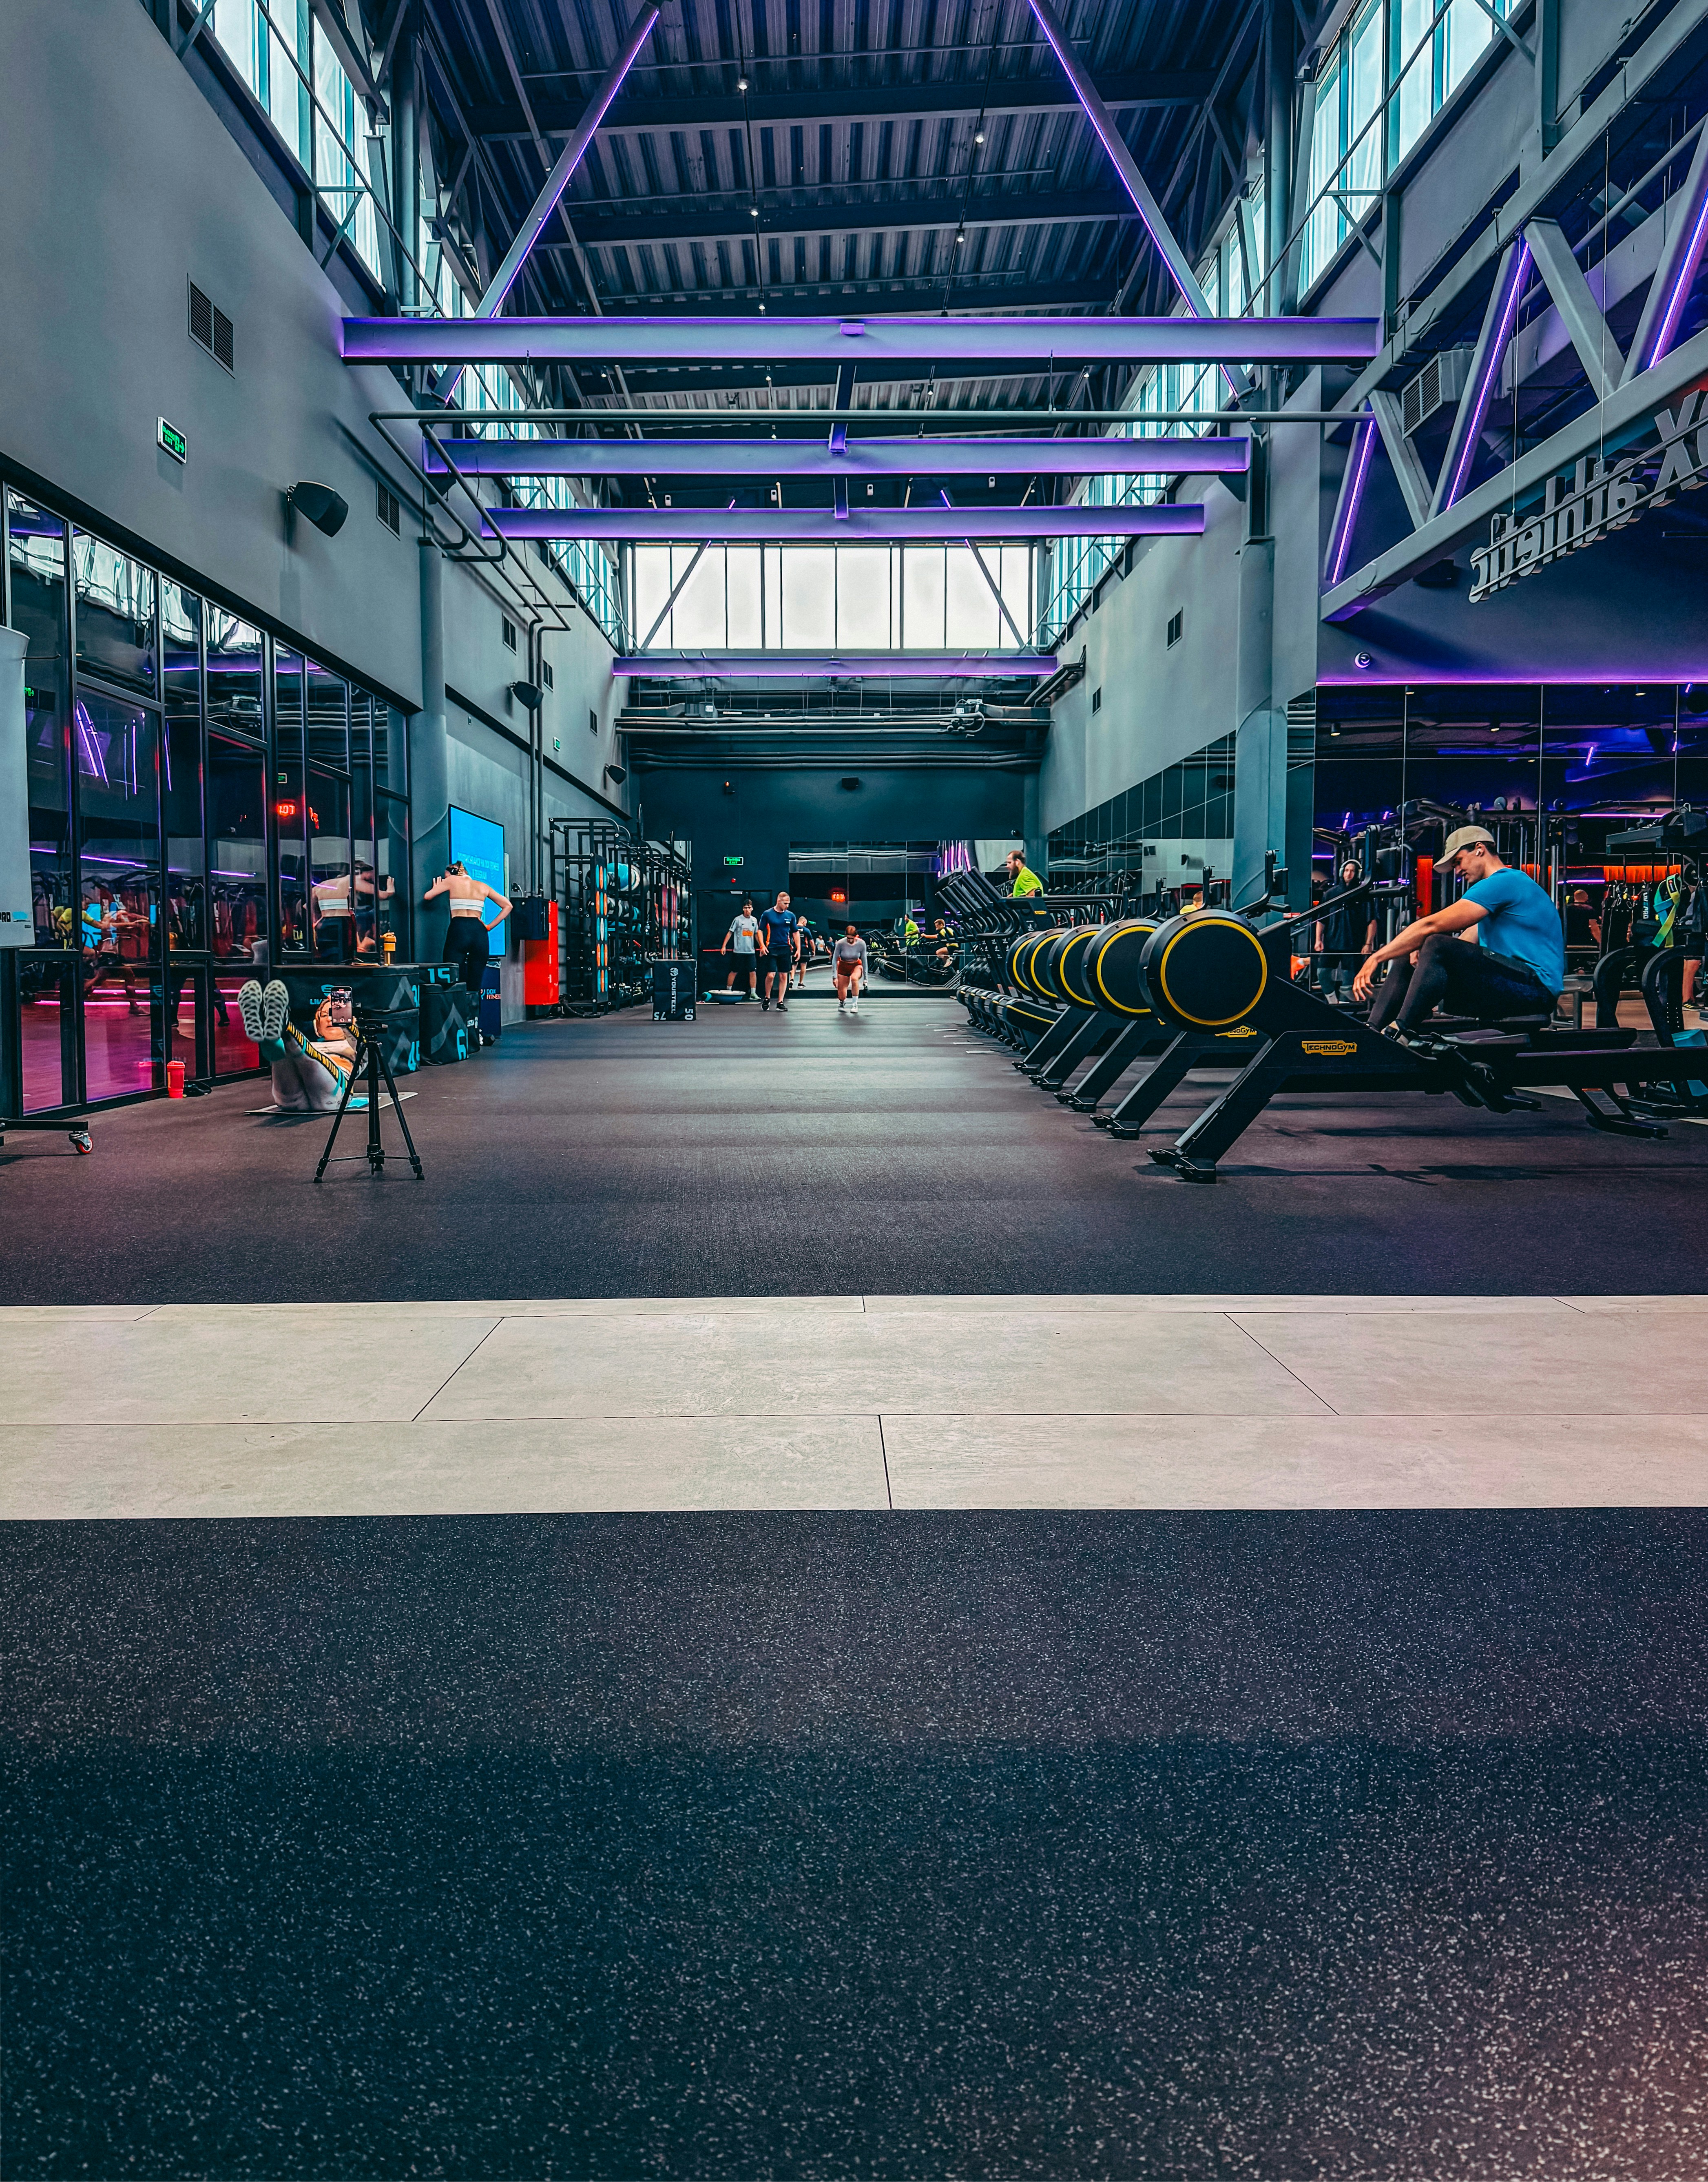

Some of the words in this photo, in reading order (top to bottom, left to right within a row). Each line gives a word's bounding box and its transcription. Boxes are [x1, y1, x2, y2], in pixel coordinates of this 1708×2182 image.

[654, 1012, 666, 1020] 75
[685, 1008, 694, 1020] 50
[1303, 1042, 1356, 1052] TECHNOGYM
